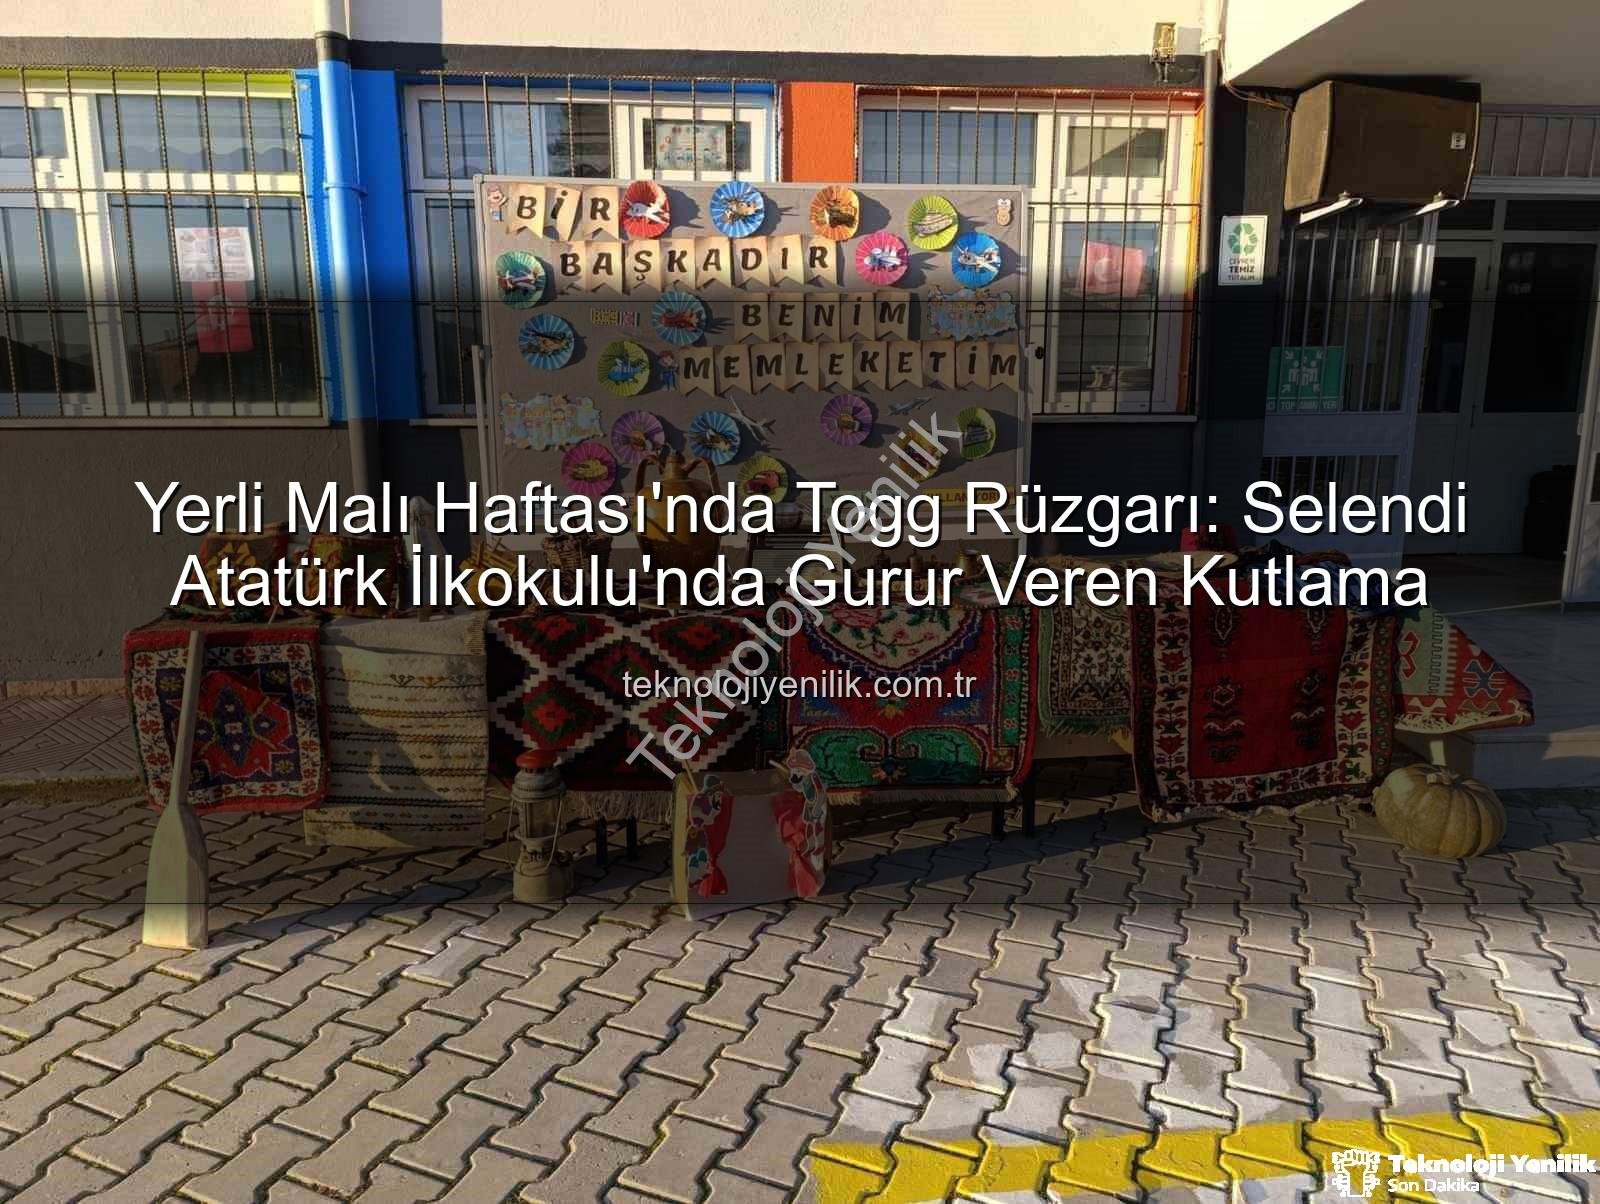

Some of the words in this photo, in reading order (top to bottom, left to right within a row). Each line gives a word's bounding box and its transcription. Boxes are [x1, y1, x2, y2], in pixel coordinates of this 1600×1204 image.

[517, 190, 611, 222] BİR
[560, 245, 829, 281] BAŞKADIR
[1228, 264, 1256, 273] TEMİZ
[742, 296, 907, 327] BENİM
[683, 345, 1017, 379] MEMLEKETİM
